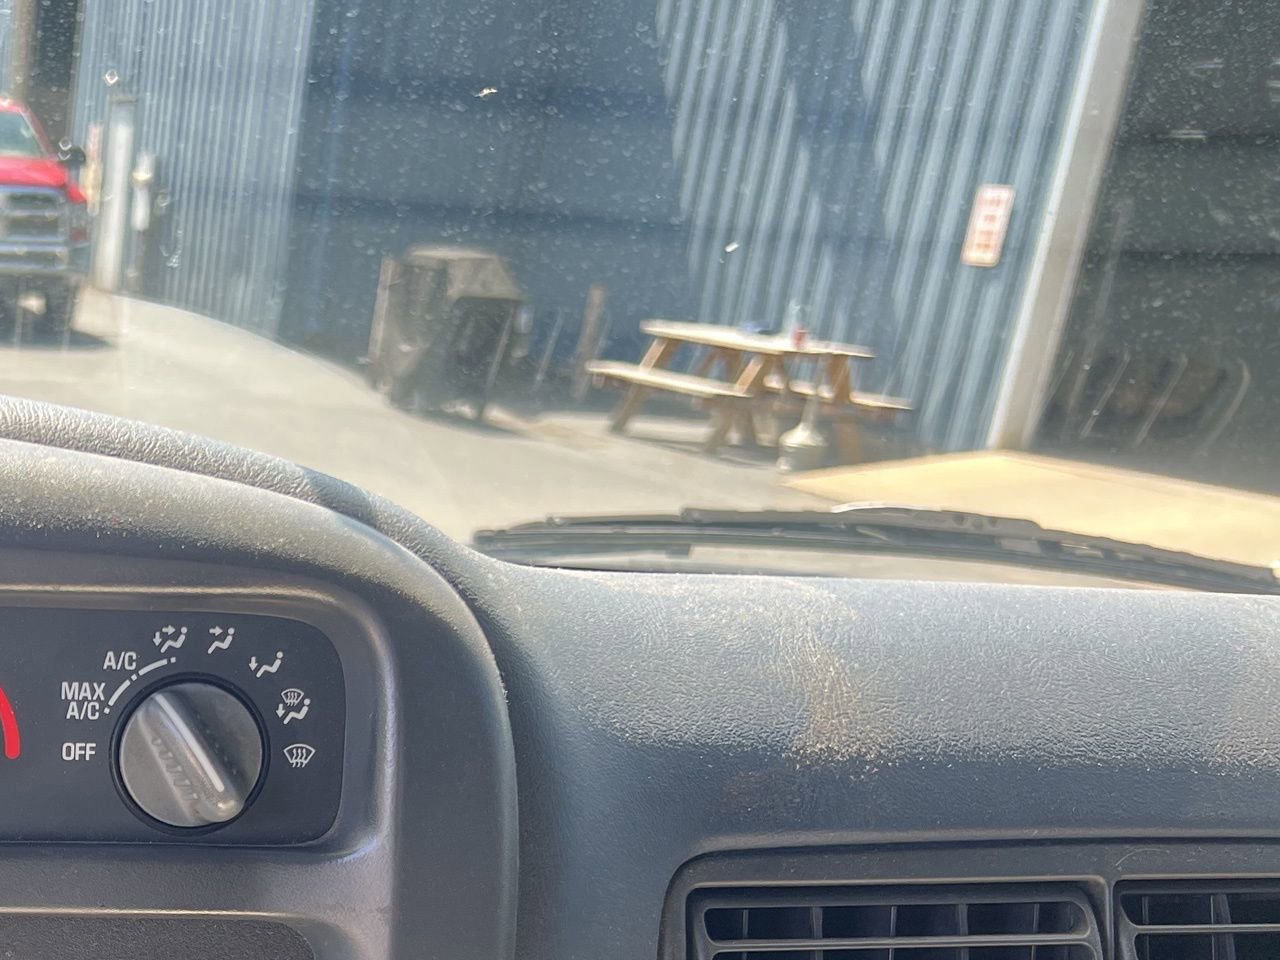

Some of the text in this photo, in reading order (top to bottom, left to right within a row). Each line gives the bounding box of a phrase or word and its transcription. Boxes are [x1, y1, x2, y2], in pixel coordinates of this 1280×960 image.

[103, 651, 137, 671] A/C
[61, 682, 106, 700] MAX
[66, 702, 100, 720] A/C
[62, 743, 96, 761] OFF
